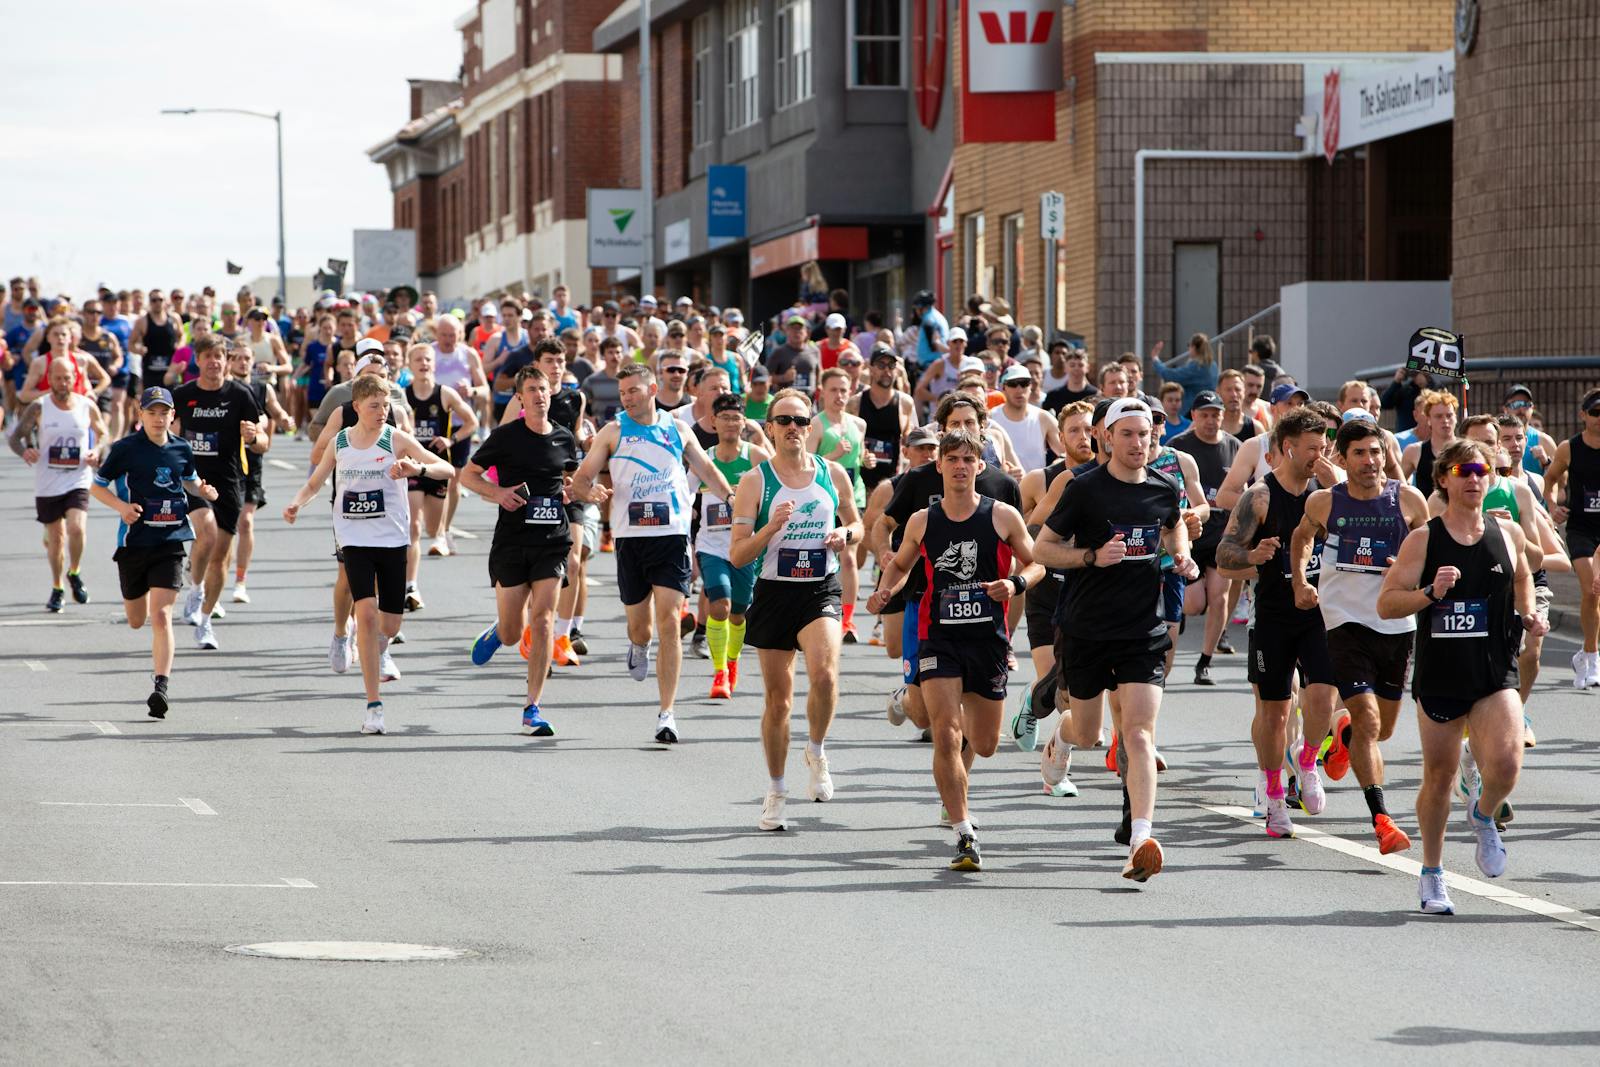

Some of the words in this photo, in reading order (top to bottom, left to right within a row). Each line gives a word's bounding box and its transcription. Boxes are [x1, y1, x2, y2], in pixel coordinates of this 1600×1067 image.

[1361, 86, 1374, 117] The
[1376, 78, 1412, 114] Salvation
[1414, 72, 1436, 108] Army
[1412, 339, 1461, 370] 40
[1421, 364, 1462, 378] ANGEL
[349, 500, 377, 512] 2299
[533, 507, 557, 519] 2263
[786, 520, 826, 531] Sydney
[1127, 537, 1144, 546] 1085
[1356, 547, 1372, 556] 606
[795, 560, 810, 568] 408
[1353, 555, 1374, 565] LINK
[791, 568, 814, 577] DIETZ
[948, 602, 981, 617] 1380
[1443, 615, 1475, 630] 1129
